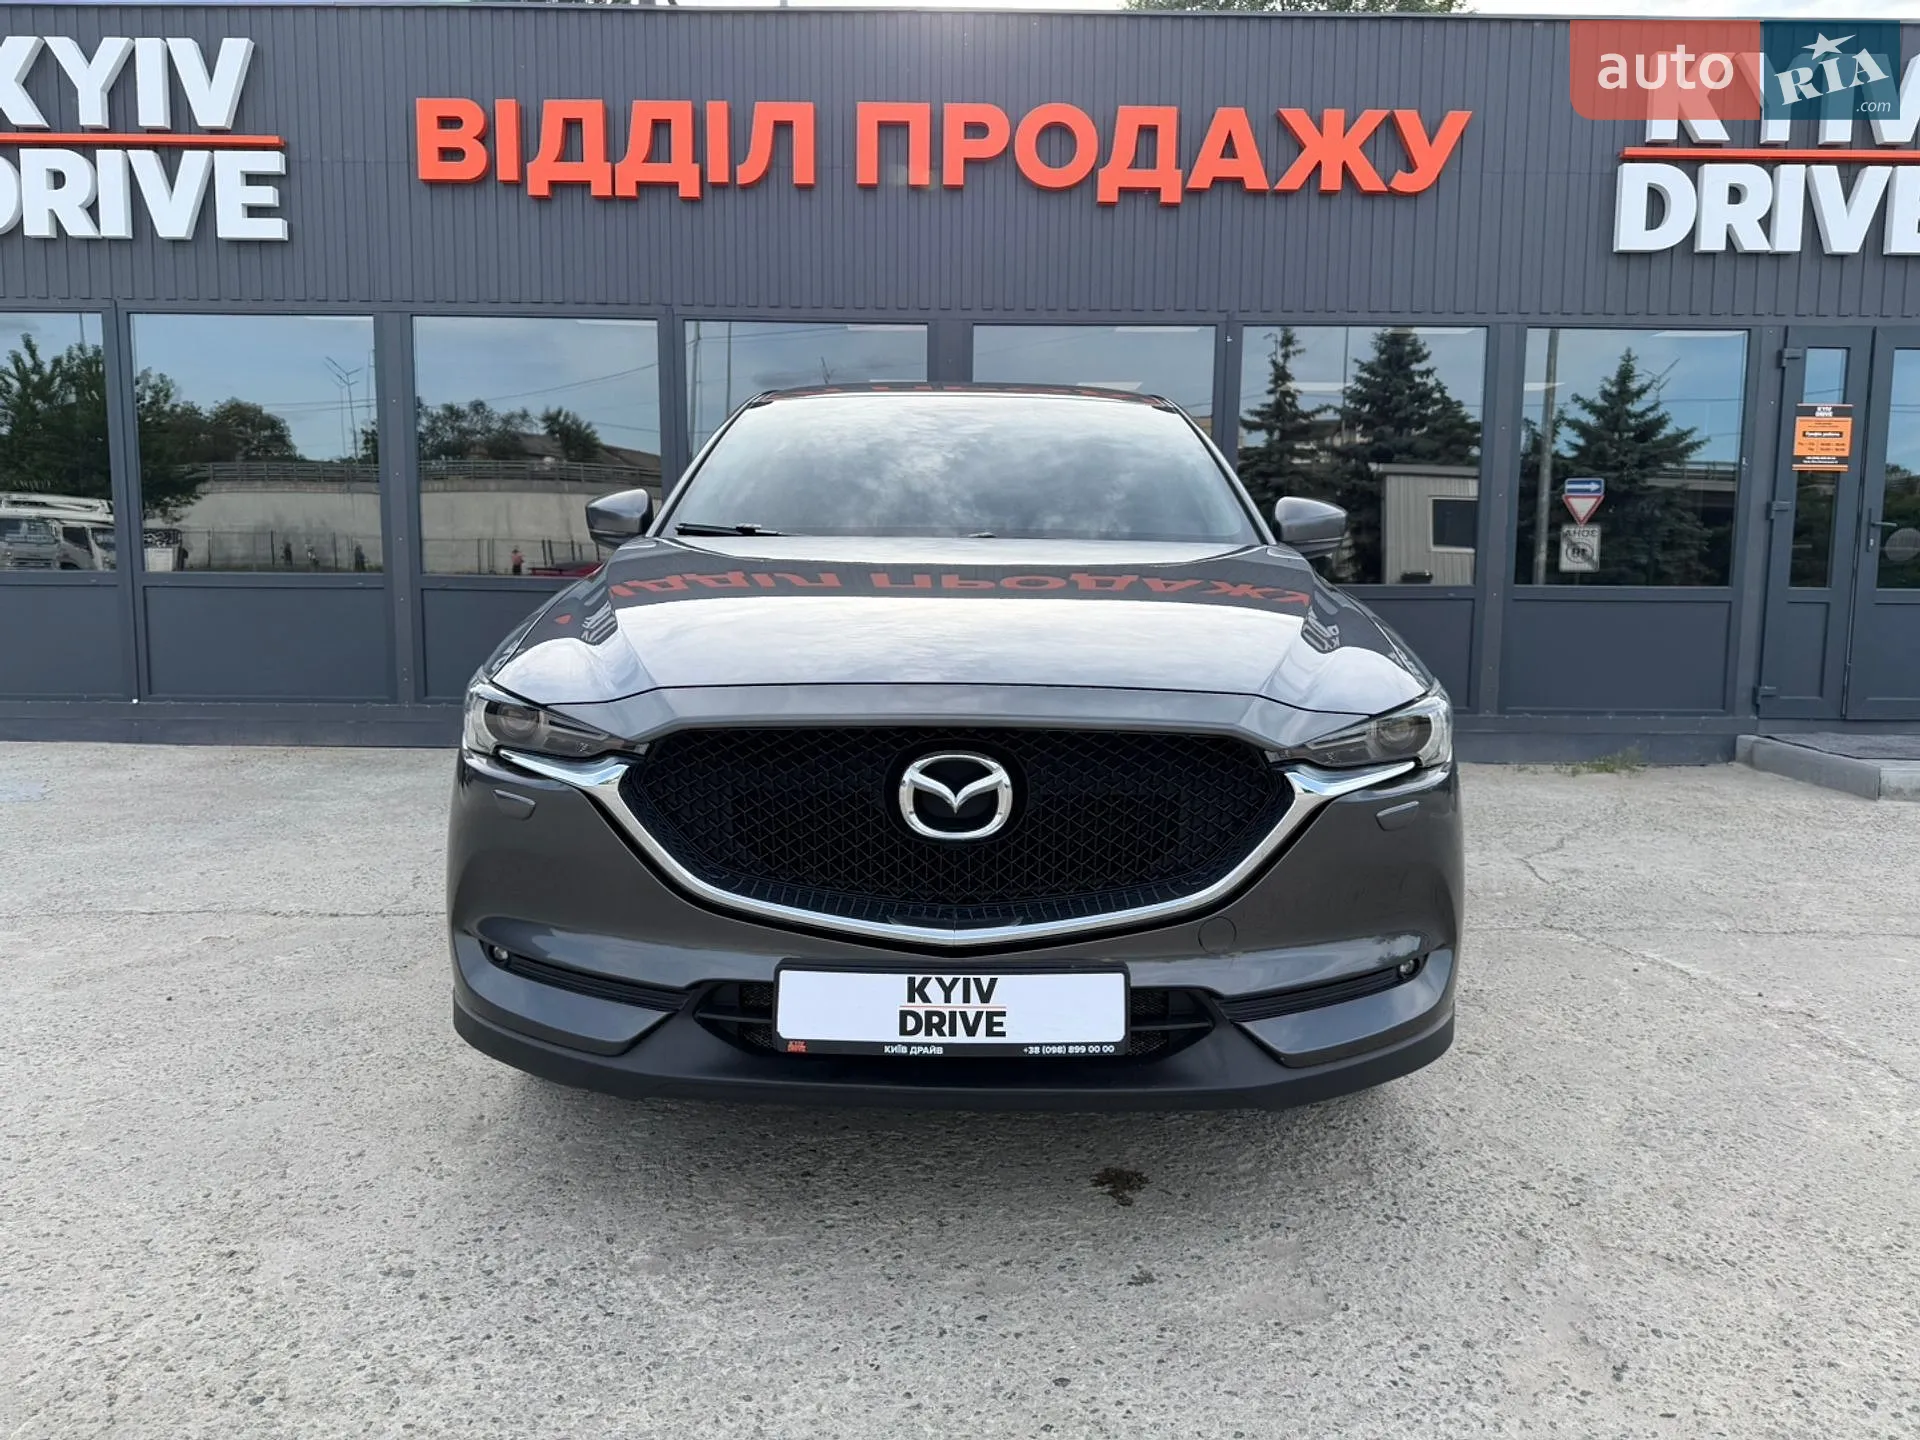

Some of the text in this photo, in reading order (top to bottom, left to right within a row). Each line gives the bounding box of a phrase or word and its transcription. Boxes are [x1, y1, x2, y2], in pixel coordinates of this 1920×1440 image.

[416, 97, 1473, 205] ВІДДІЛ ПРОДАЖУ
[906, 976, 998, 1004] KYIV
[899, 1010, 1007, 1038] DRIVE
[909, 1044, 944, 1055] ДРАЙВ
[1088, 1045, 1101, 1054] 00
[1102, 1045, 1115, 1054] 00
